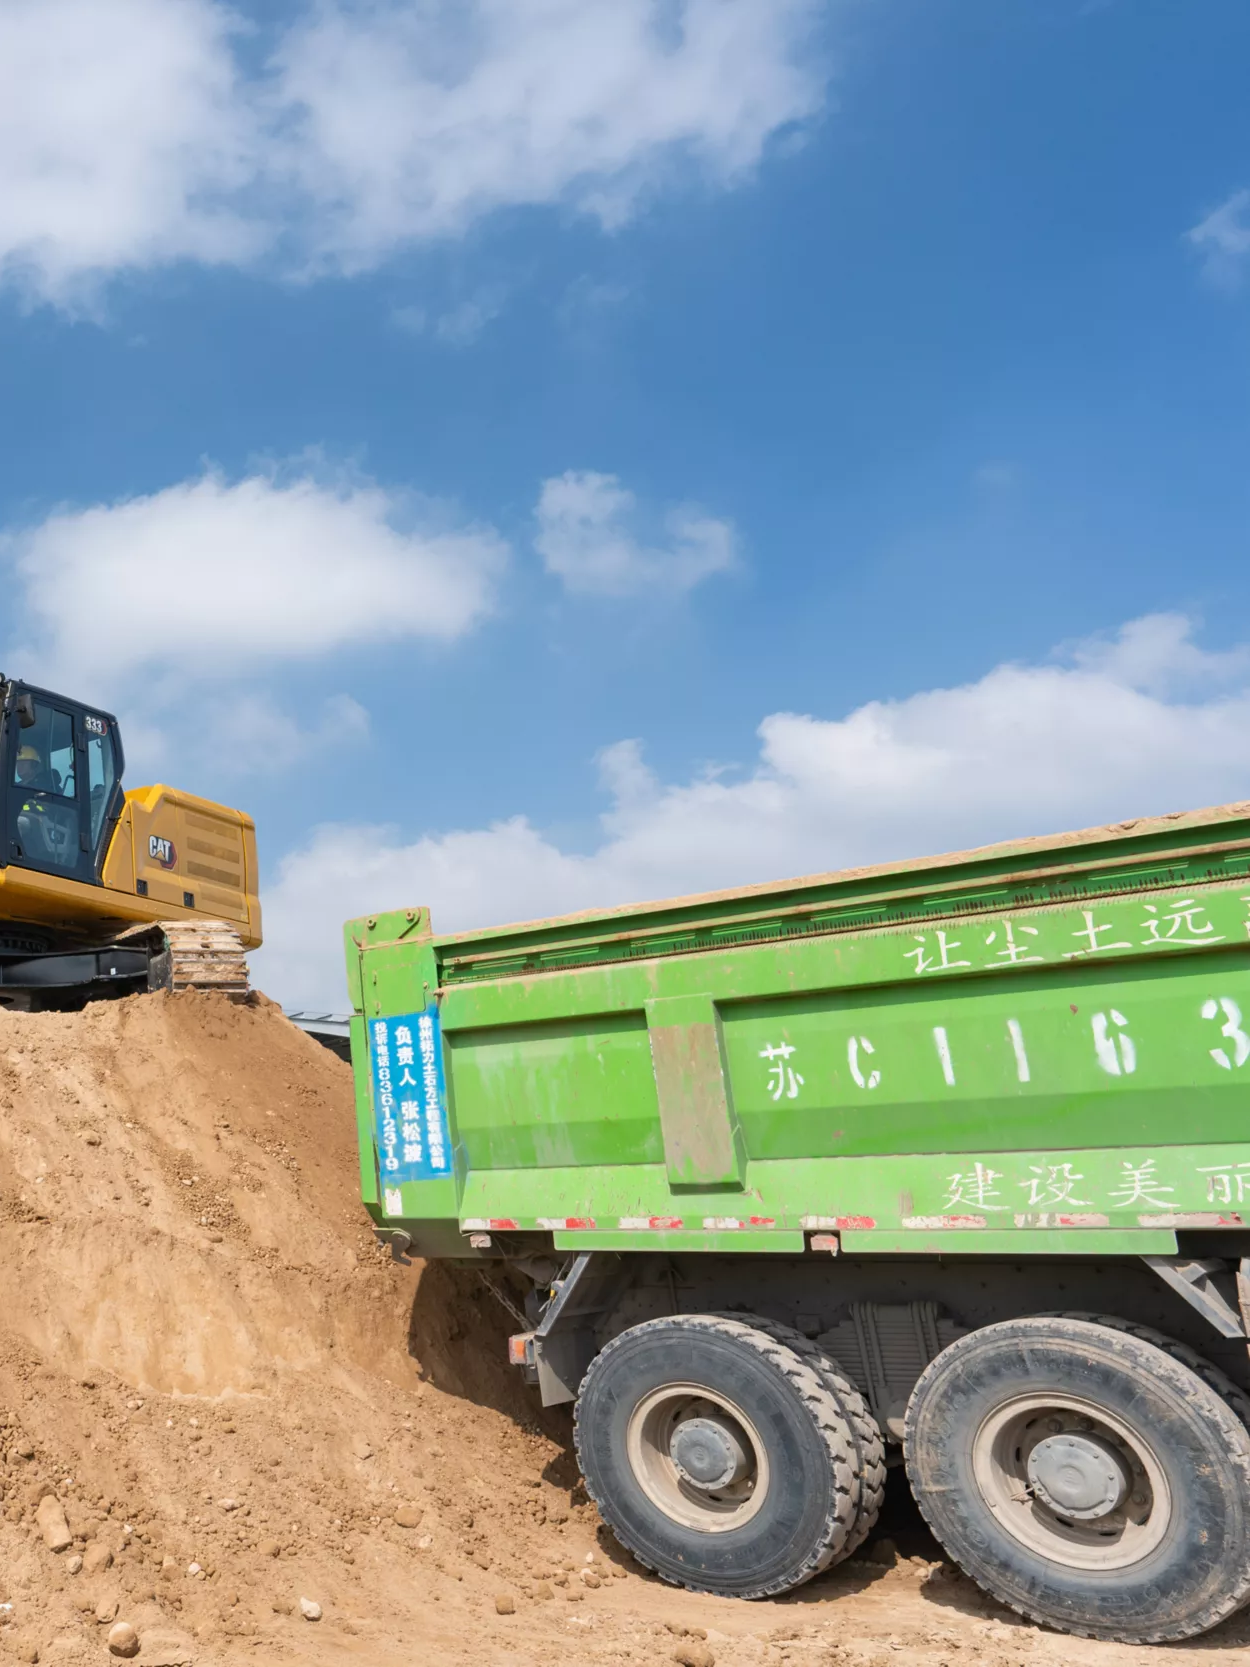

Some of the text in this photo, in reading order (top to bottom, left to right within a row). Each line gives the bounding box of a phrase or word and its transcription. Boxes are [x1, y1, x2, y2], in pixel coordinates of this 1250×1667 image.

[85, 715, 103, 733] 333
[149, 835, 172, 862] CAT
[903, 896, 1250, 974] 让尘土远
[394, 1026, 417, 1087] 负责人
[942, 1158, 1250, 1210] 建设美丽
